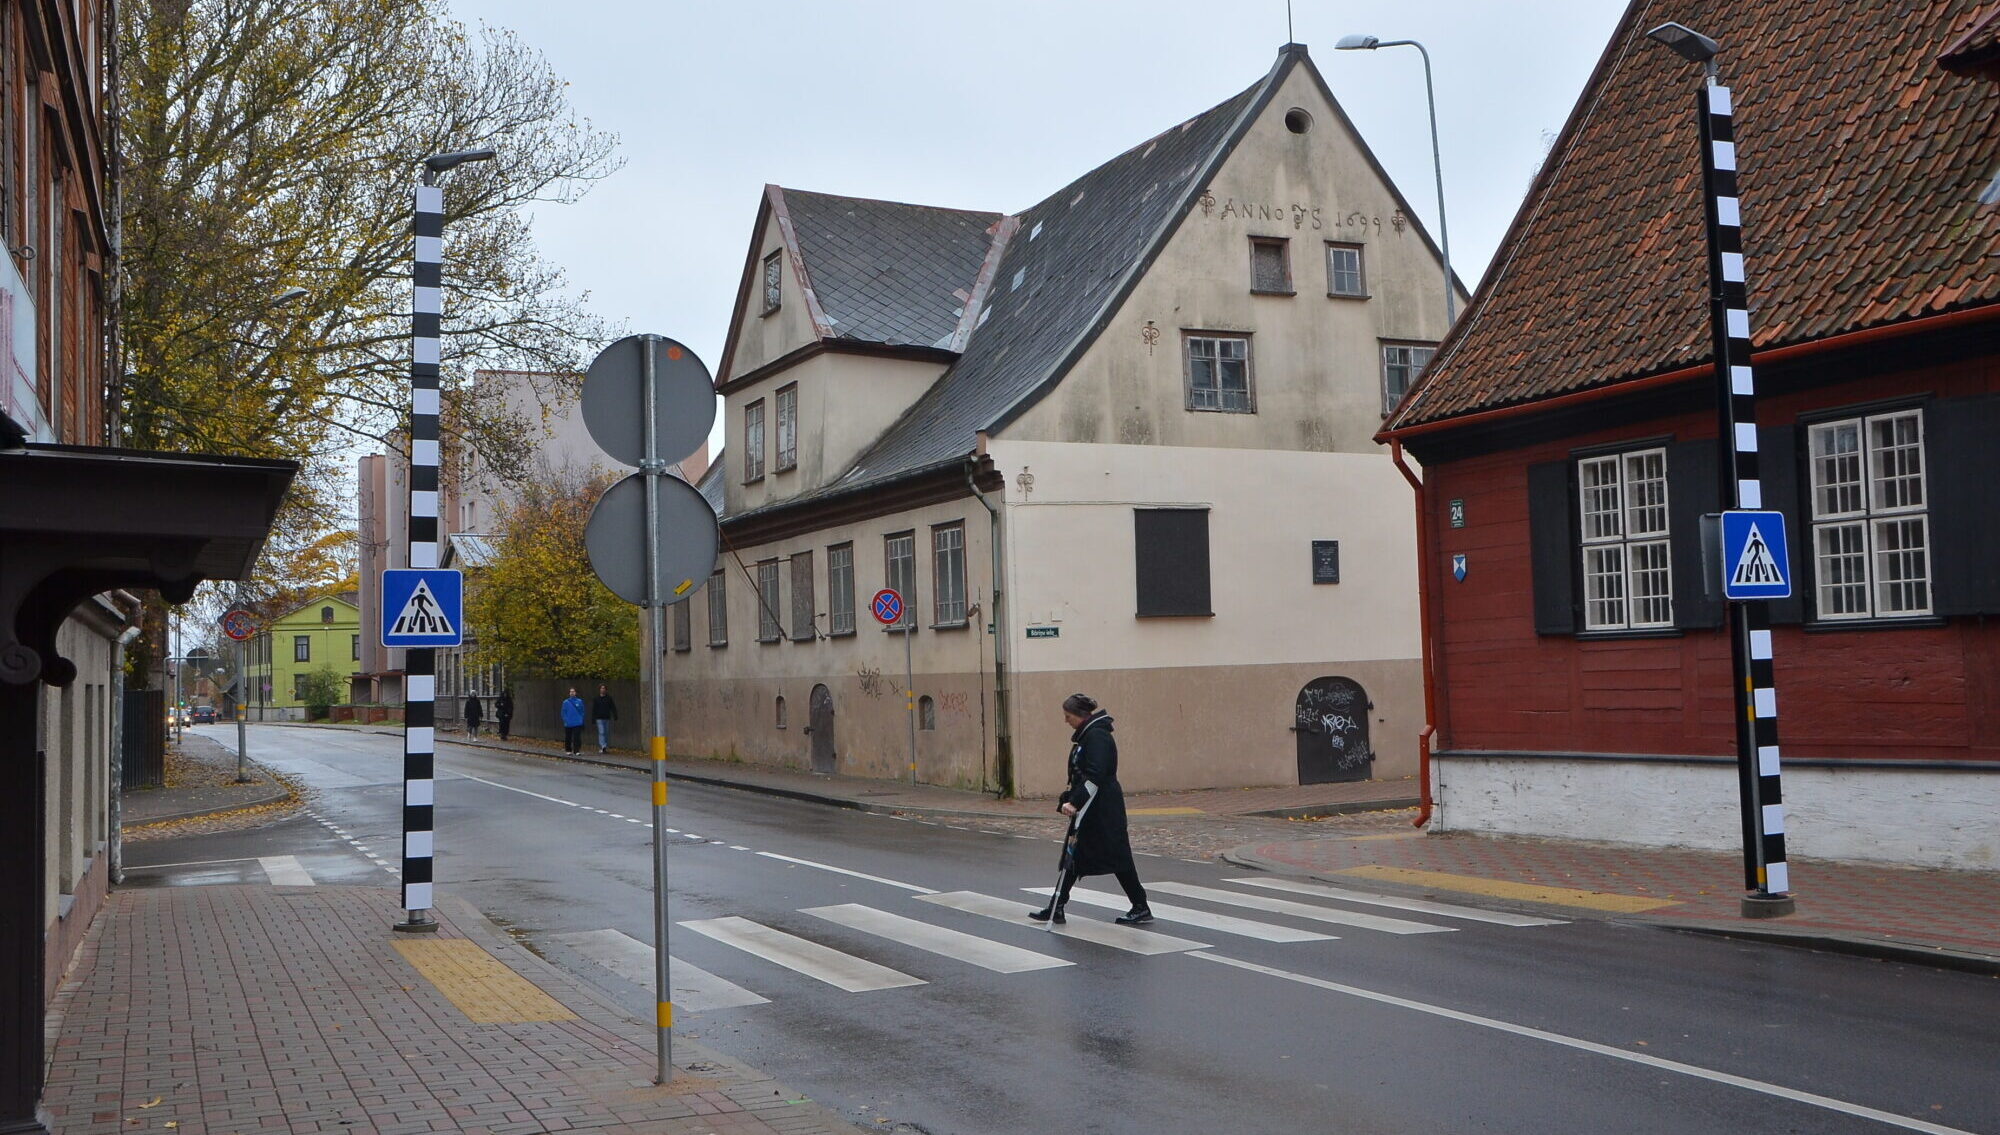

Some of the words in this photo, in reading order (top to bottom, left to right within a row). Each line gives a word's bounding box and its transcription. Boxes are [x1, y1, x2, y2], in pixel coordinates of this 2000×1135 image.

[1221, 198, 1284, 221] ANNO
[1335, 211, 1381, 237] 1699
[1451, 506, 1463, 520] 24
